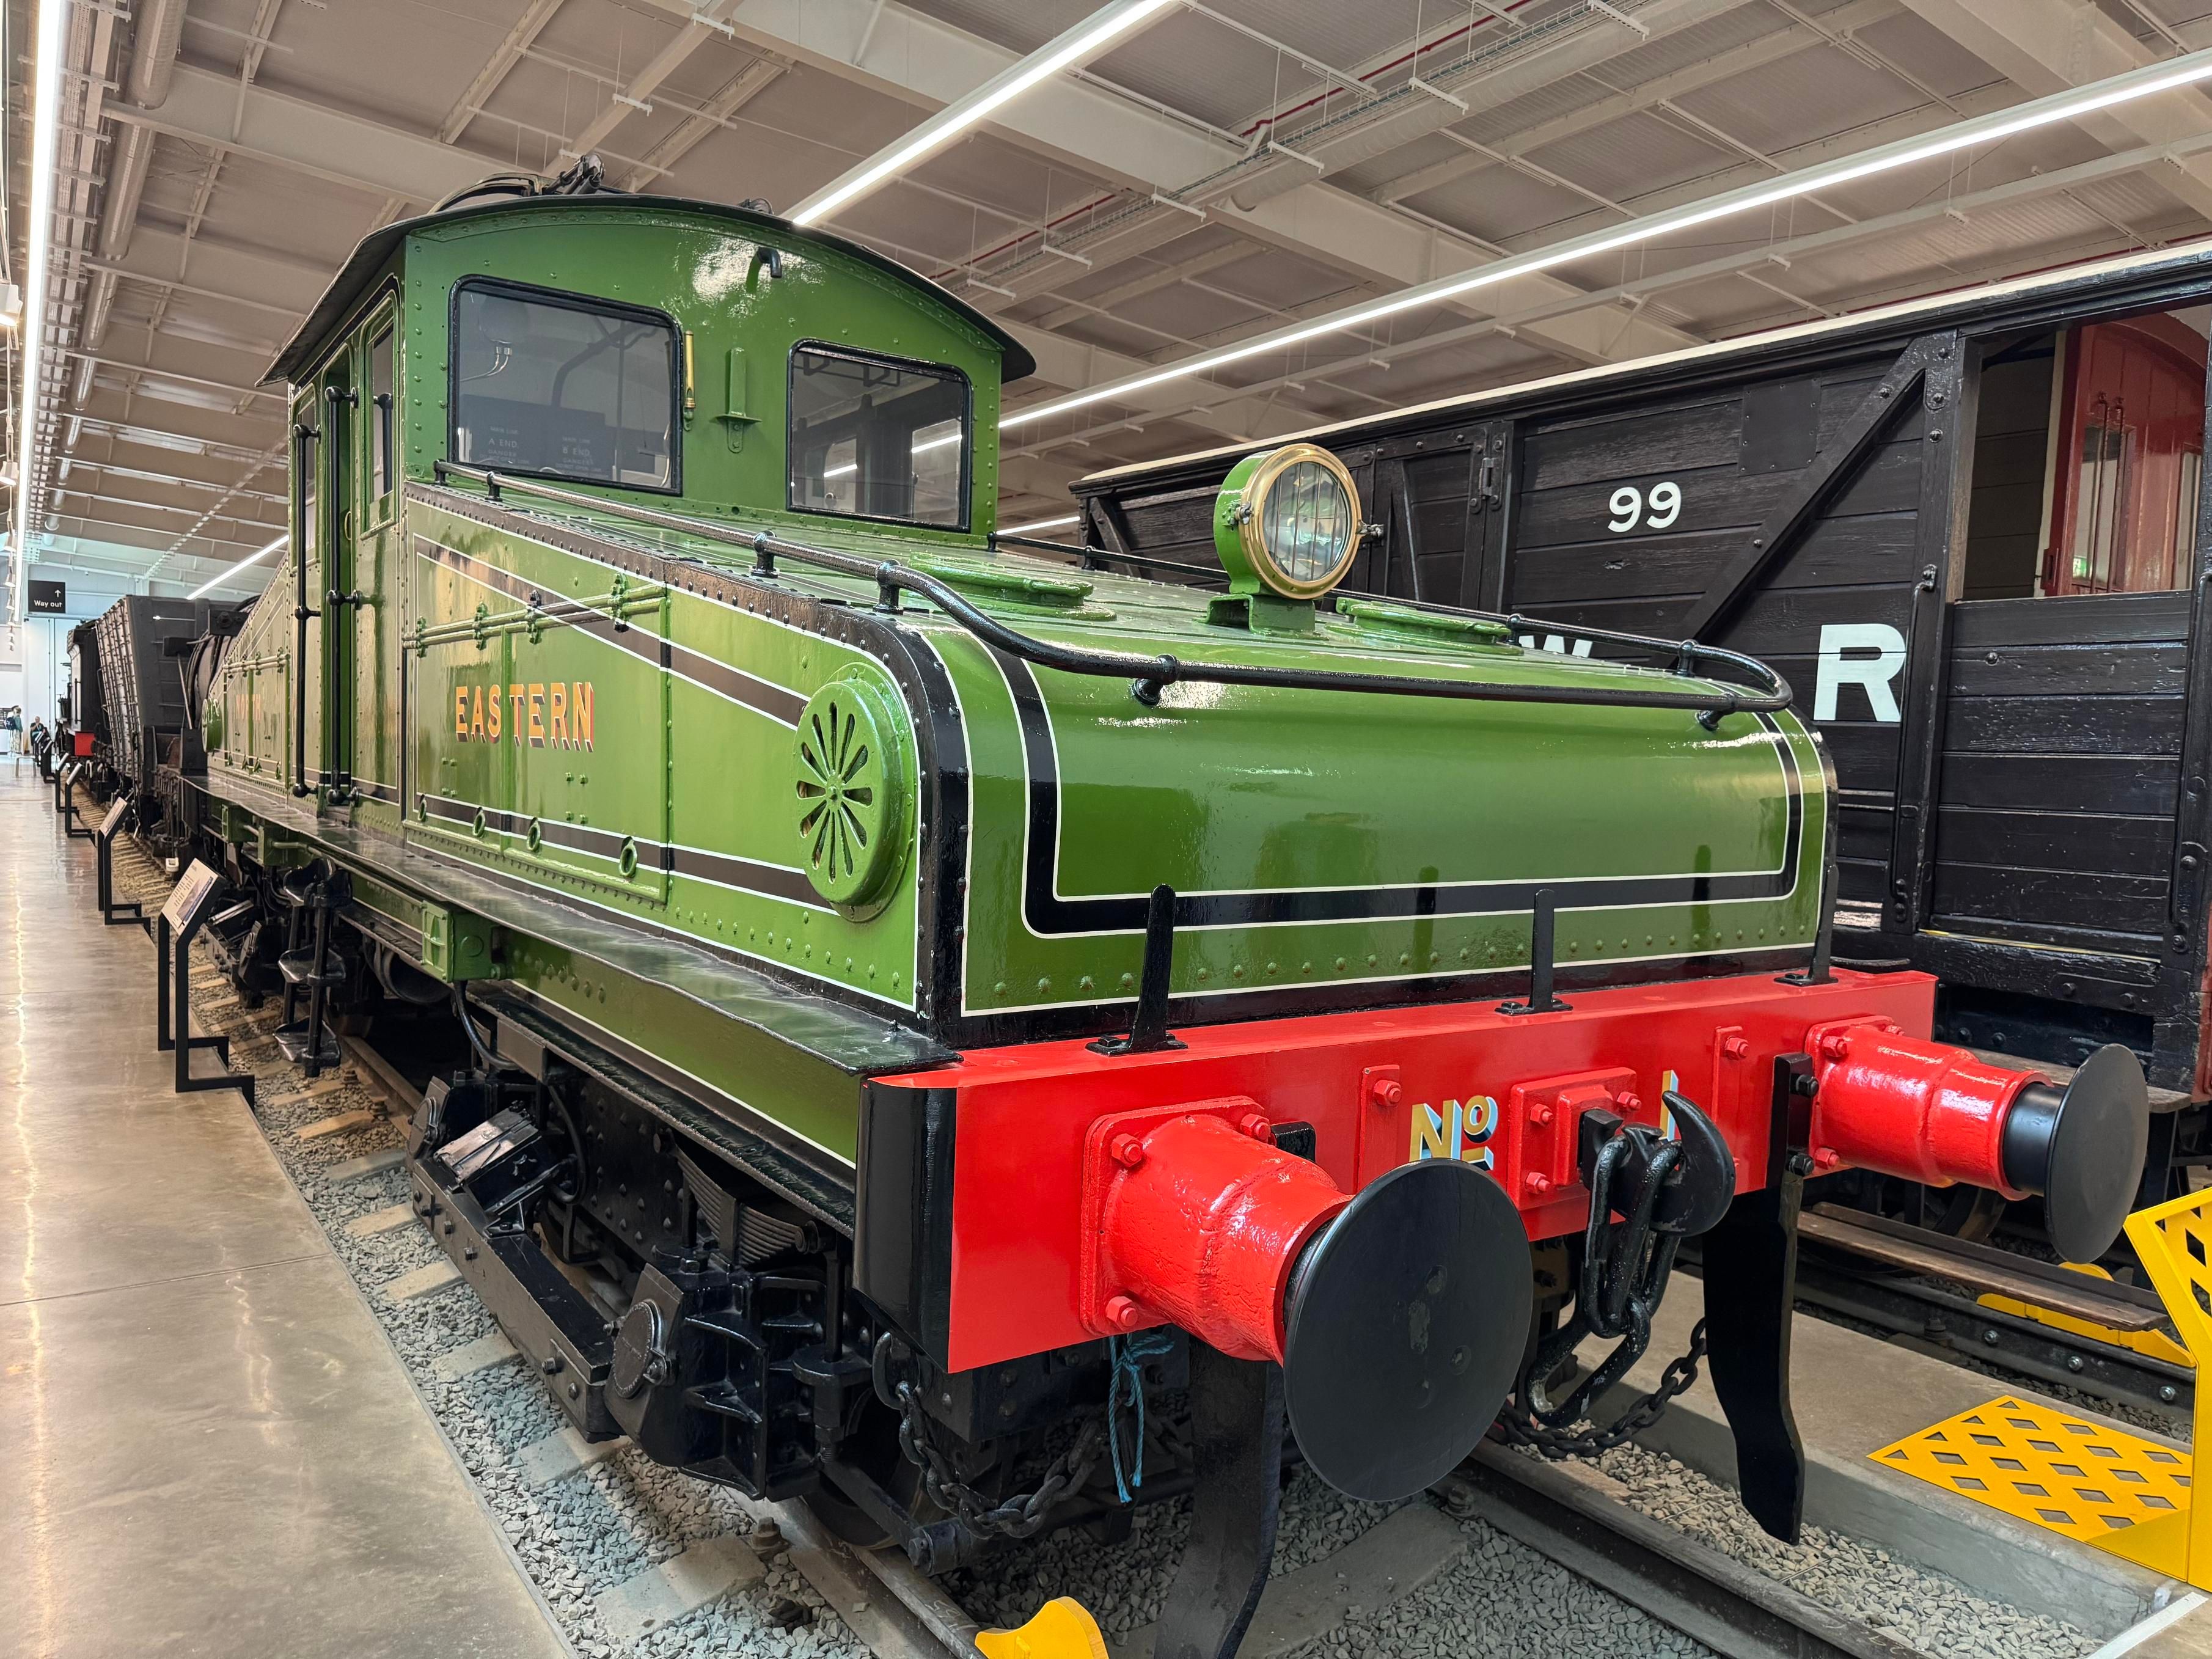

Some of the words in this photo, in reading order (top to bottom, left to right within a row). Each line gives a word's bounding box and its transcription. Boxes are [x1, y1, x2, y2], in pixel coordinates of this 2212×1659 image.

[499, 439, 517, 448] END
[1607, 482, 1682, 533] 99
[34, 599, 49, 609] Way
[1813, 623, 1907, 722] R
[455, 681, 594, 752] EASTERN
